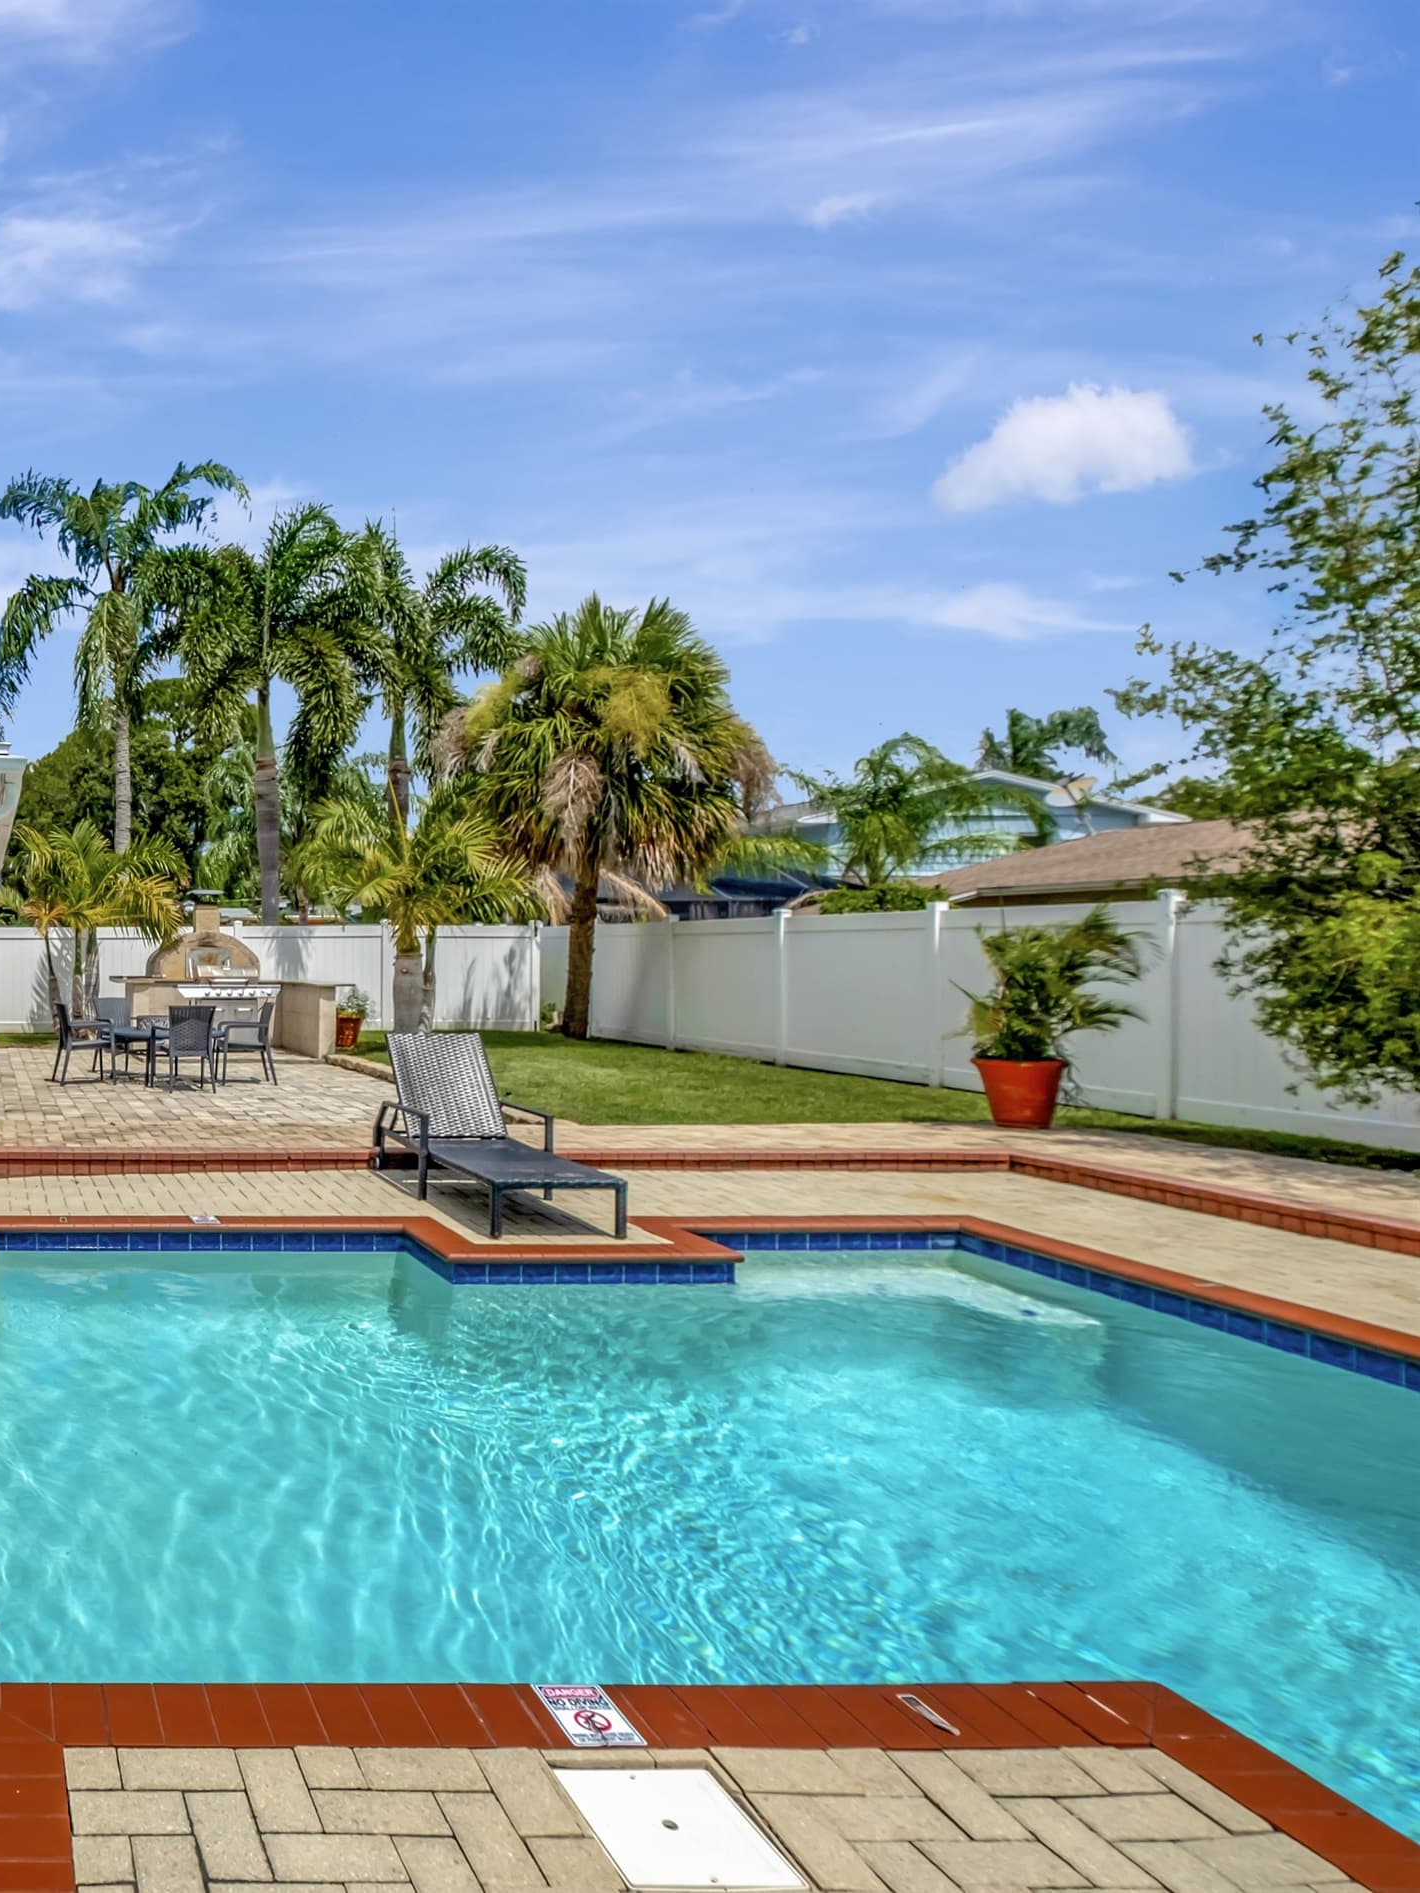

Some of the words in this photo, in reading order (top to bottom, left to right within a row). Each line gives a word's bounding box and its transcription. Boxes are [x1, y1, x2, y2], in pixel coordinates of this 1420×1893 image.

[544, 1688, 596, 1697] DANGER
[547, 1698, 566, 1706] NO
[569, 1698, 609, 1706] DIVING
